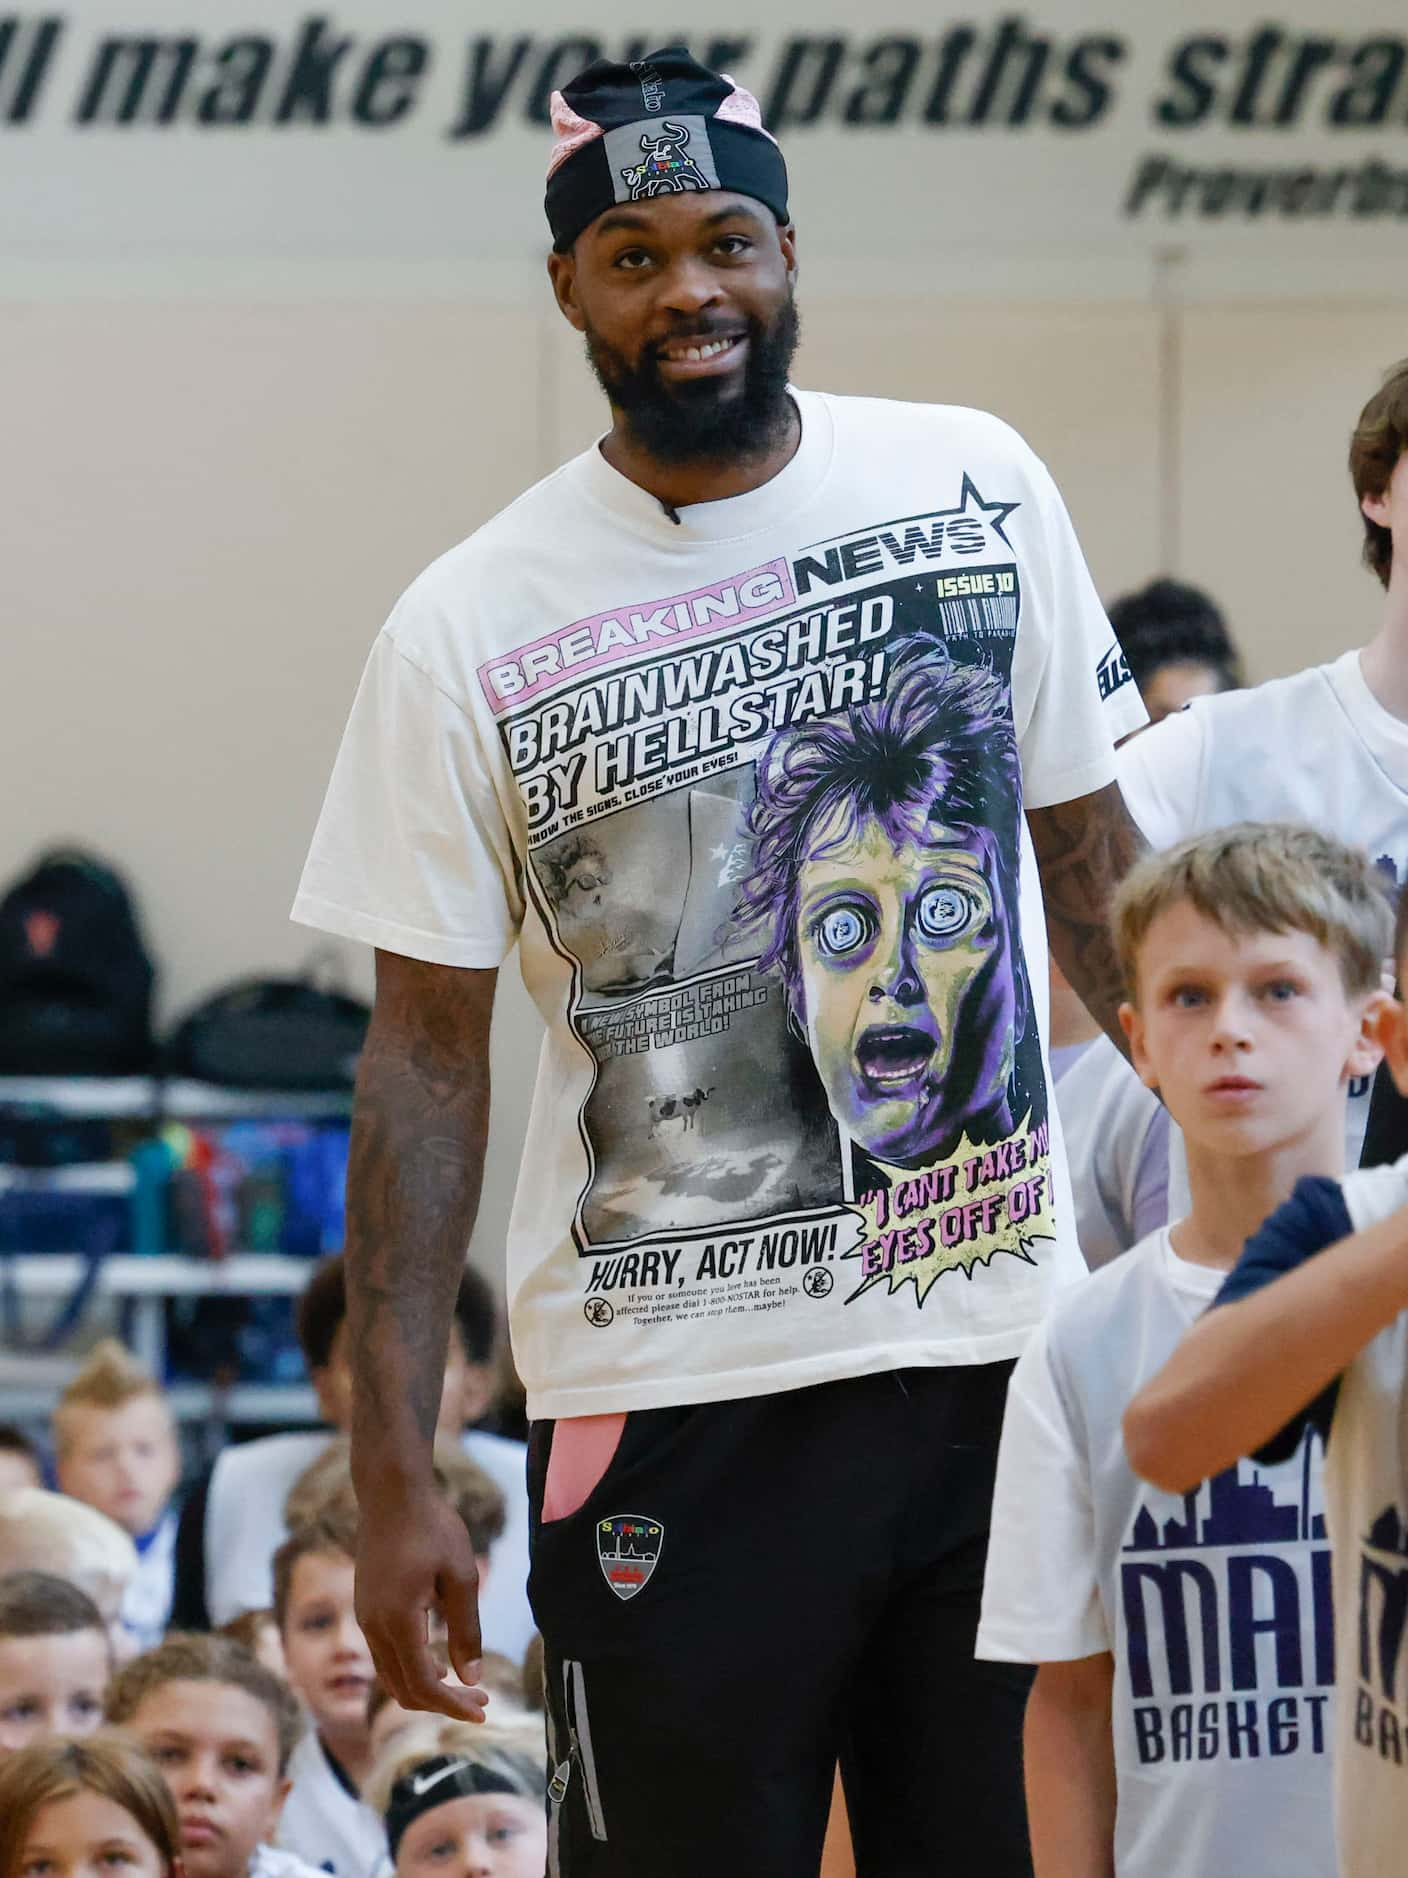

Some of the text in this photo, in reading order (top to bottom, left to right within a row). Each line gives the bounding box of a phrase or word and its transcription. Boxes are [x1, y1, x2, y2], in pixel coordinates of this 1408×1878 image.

[76, 17, 427, 128] make
[762, 18, 1128, 134] paths
[487, 518, 986, 701] BREAKING NEWS
[937, 572, 1014, 598] ISSUE 10
[509, 594, 895, 776] BRAINWASHED
[518, 650, 887, 829] BY HELLSTAR!
[562, 810, 584, 826] THE
[624, 781, 664, 802] CLOSE
[666, 766, 699, 785] YOUR
[702, 752, 739, 772] EYES!
[606, 1016, 672, 1041] FUTURE
[676, 1008, 696, 1026] IS
[625, 992, 696, 1021] SYMBOL
[700, 974, 751, 999] FROM
[615, 1035, 651, 1056] THE
[655, 1013, 730, 1049] WORLD!
[893, 1166, 959, 1219] CANT
[964, 1139, 1027, 1192] TAKE
[583, 1224, 838, 1293] HURRY, ACT NOW!
[862, 1217, 936, 1276] EYES
[940, 1194, 1006, 1248] OFF
[1007, 1175, 1046, 1224] OF
[616, 1304, 649, 1316] affected
[651, 1302, 680, 1314] please
[682, 1299, 700, 1309] dial
[763, 1288, 776, 1298] for
[778, 1285, 800, 1297] help.
[637, 1294, 653, 1303] you
[655, 1293, 665, 1301] or
[668, 1288, 708, 1299] someone
[710, 1286, 725, 1295] you
[727, 1283, 742, 1291] love
[744, 1279, 757, 1288] has
[760, 1277, 781, 1286] been
[676, 1312, 689, 1320] we
[690, 1311, 705, 1319] can
[1133, 1696, 1329, 1764] BASKET
